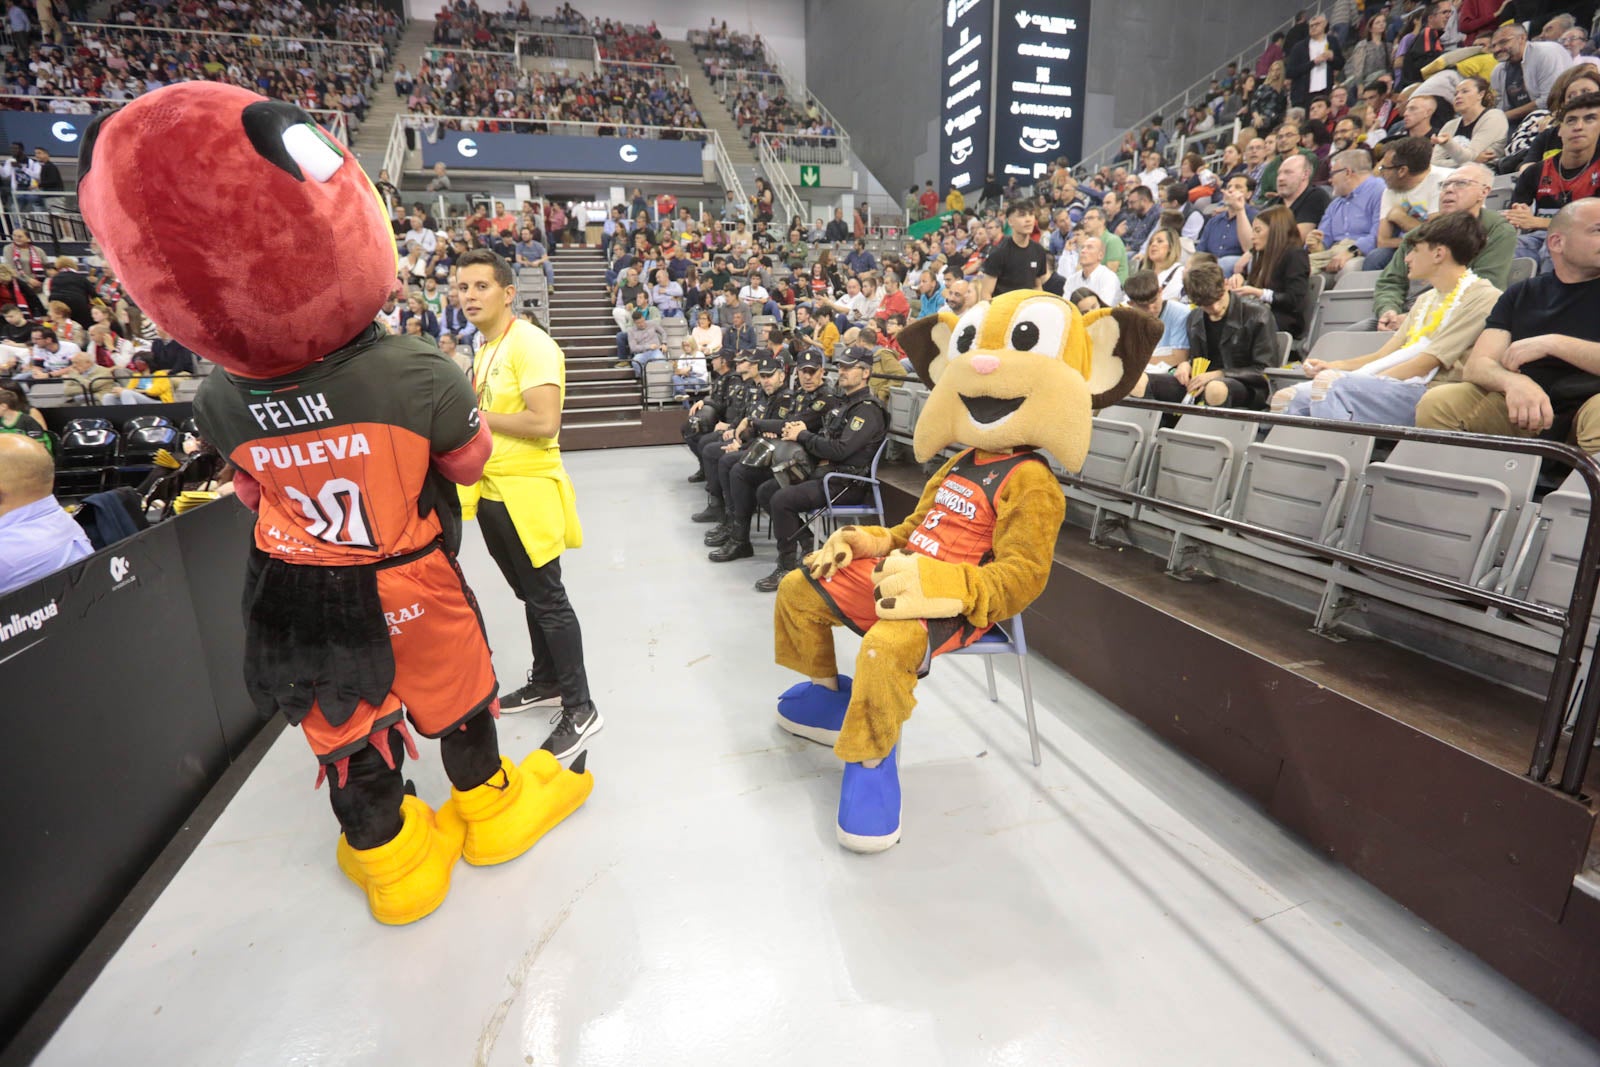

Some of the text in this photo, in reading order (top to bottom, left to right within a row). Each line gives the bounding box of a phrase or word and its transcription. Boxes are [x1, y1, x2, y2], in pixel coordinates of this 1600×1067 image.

[248, 393, 334, 430] FÉLIX
[249, 433, 371, 471] PULEVA
[909, 530, 940, 557] LEVA
[0, 600, 58, 642] inlingua
[384, 603, 425, 626] RAL
